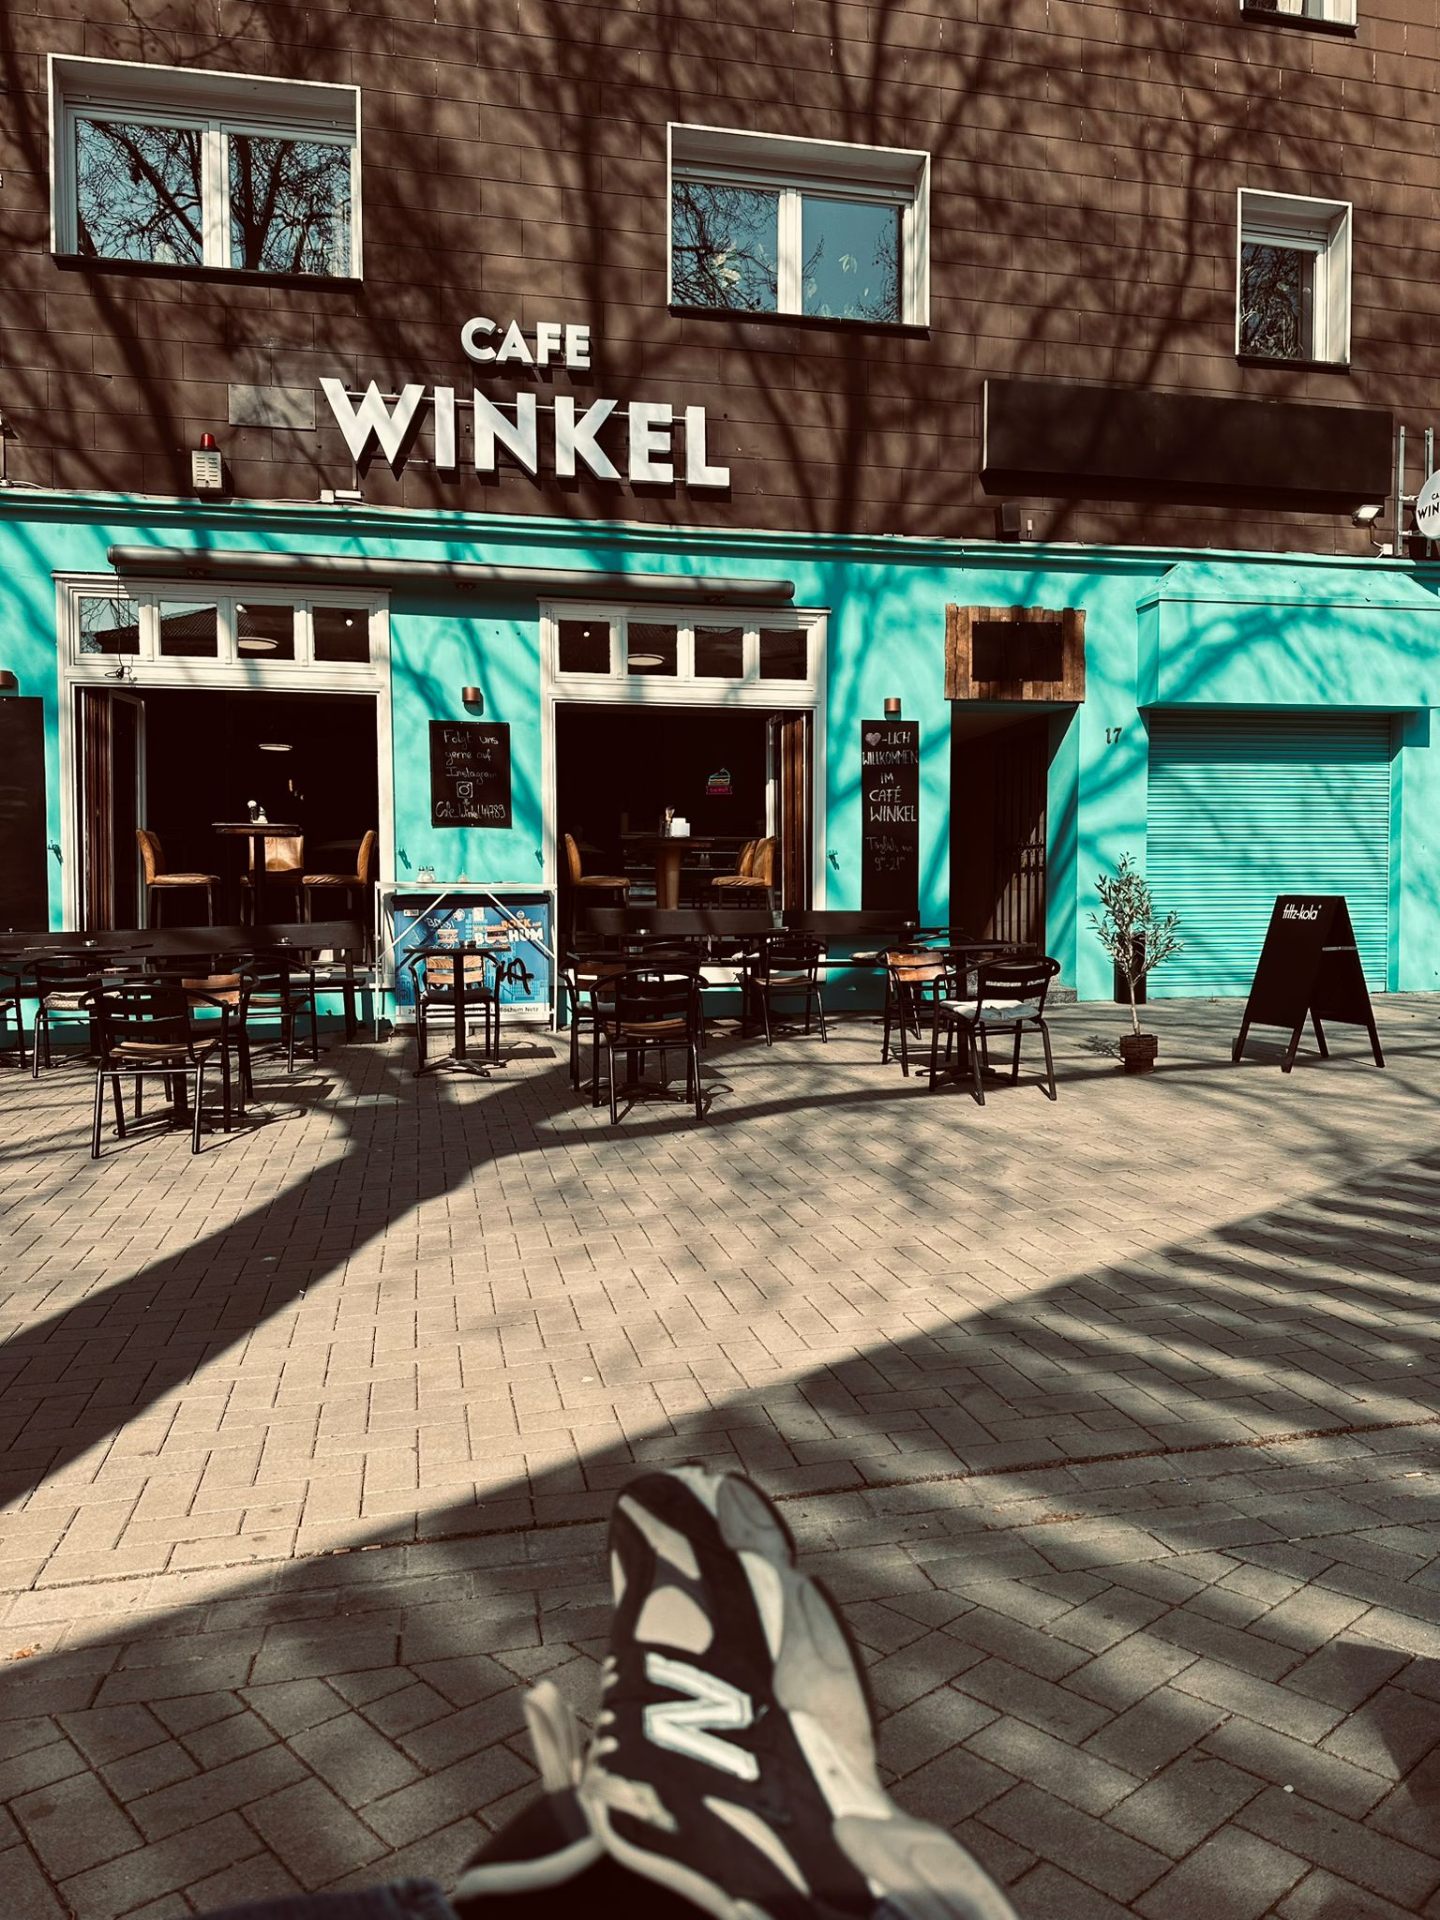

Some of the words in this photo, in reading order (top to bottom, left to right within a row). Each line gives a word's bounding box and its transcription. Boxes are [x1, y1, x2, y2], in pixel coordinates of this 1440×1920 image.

[461, 317, 591, 370] CAFE
[318, 377, 730, 488] WINKEL
[443, 729, 472, 750] Folgt
[479, 735, 499, 745] uns
[1105, 727, 1122, 744] 17
[444, 750, 472, 766] gerne
[476, 748, 492, 761] auf
[862, 749, 919, 766] WILLKOMMEN
[869, 785, 902, 803] CAFÉ
[870, 805, 917, 822] WINKEL
